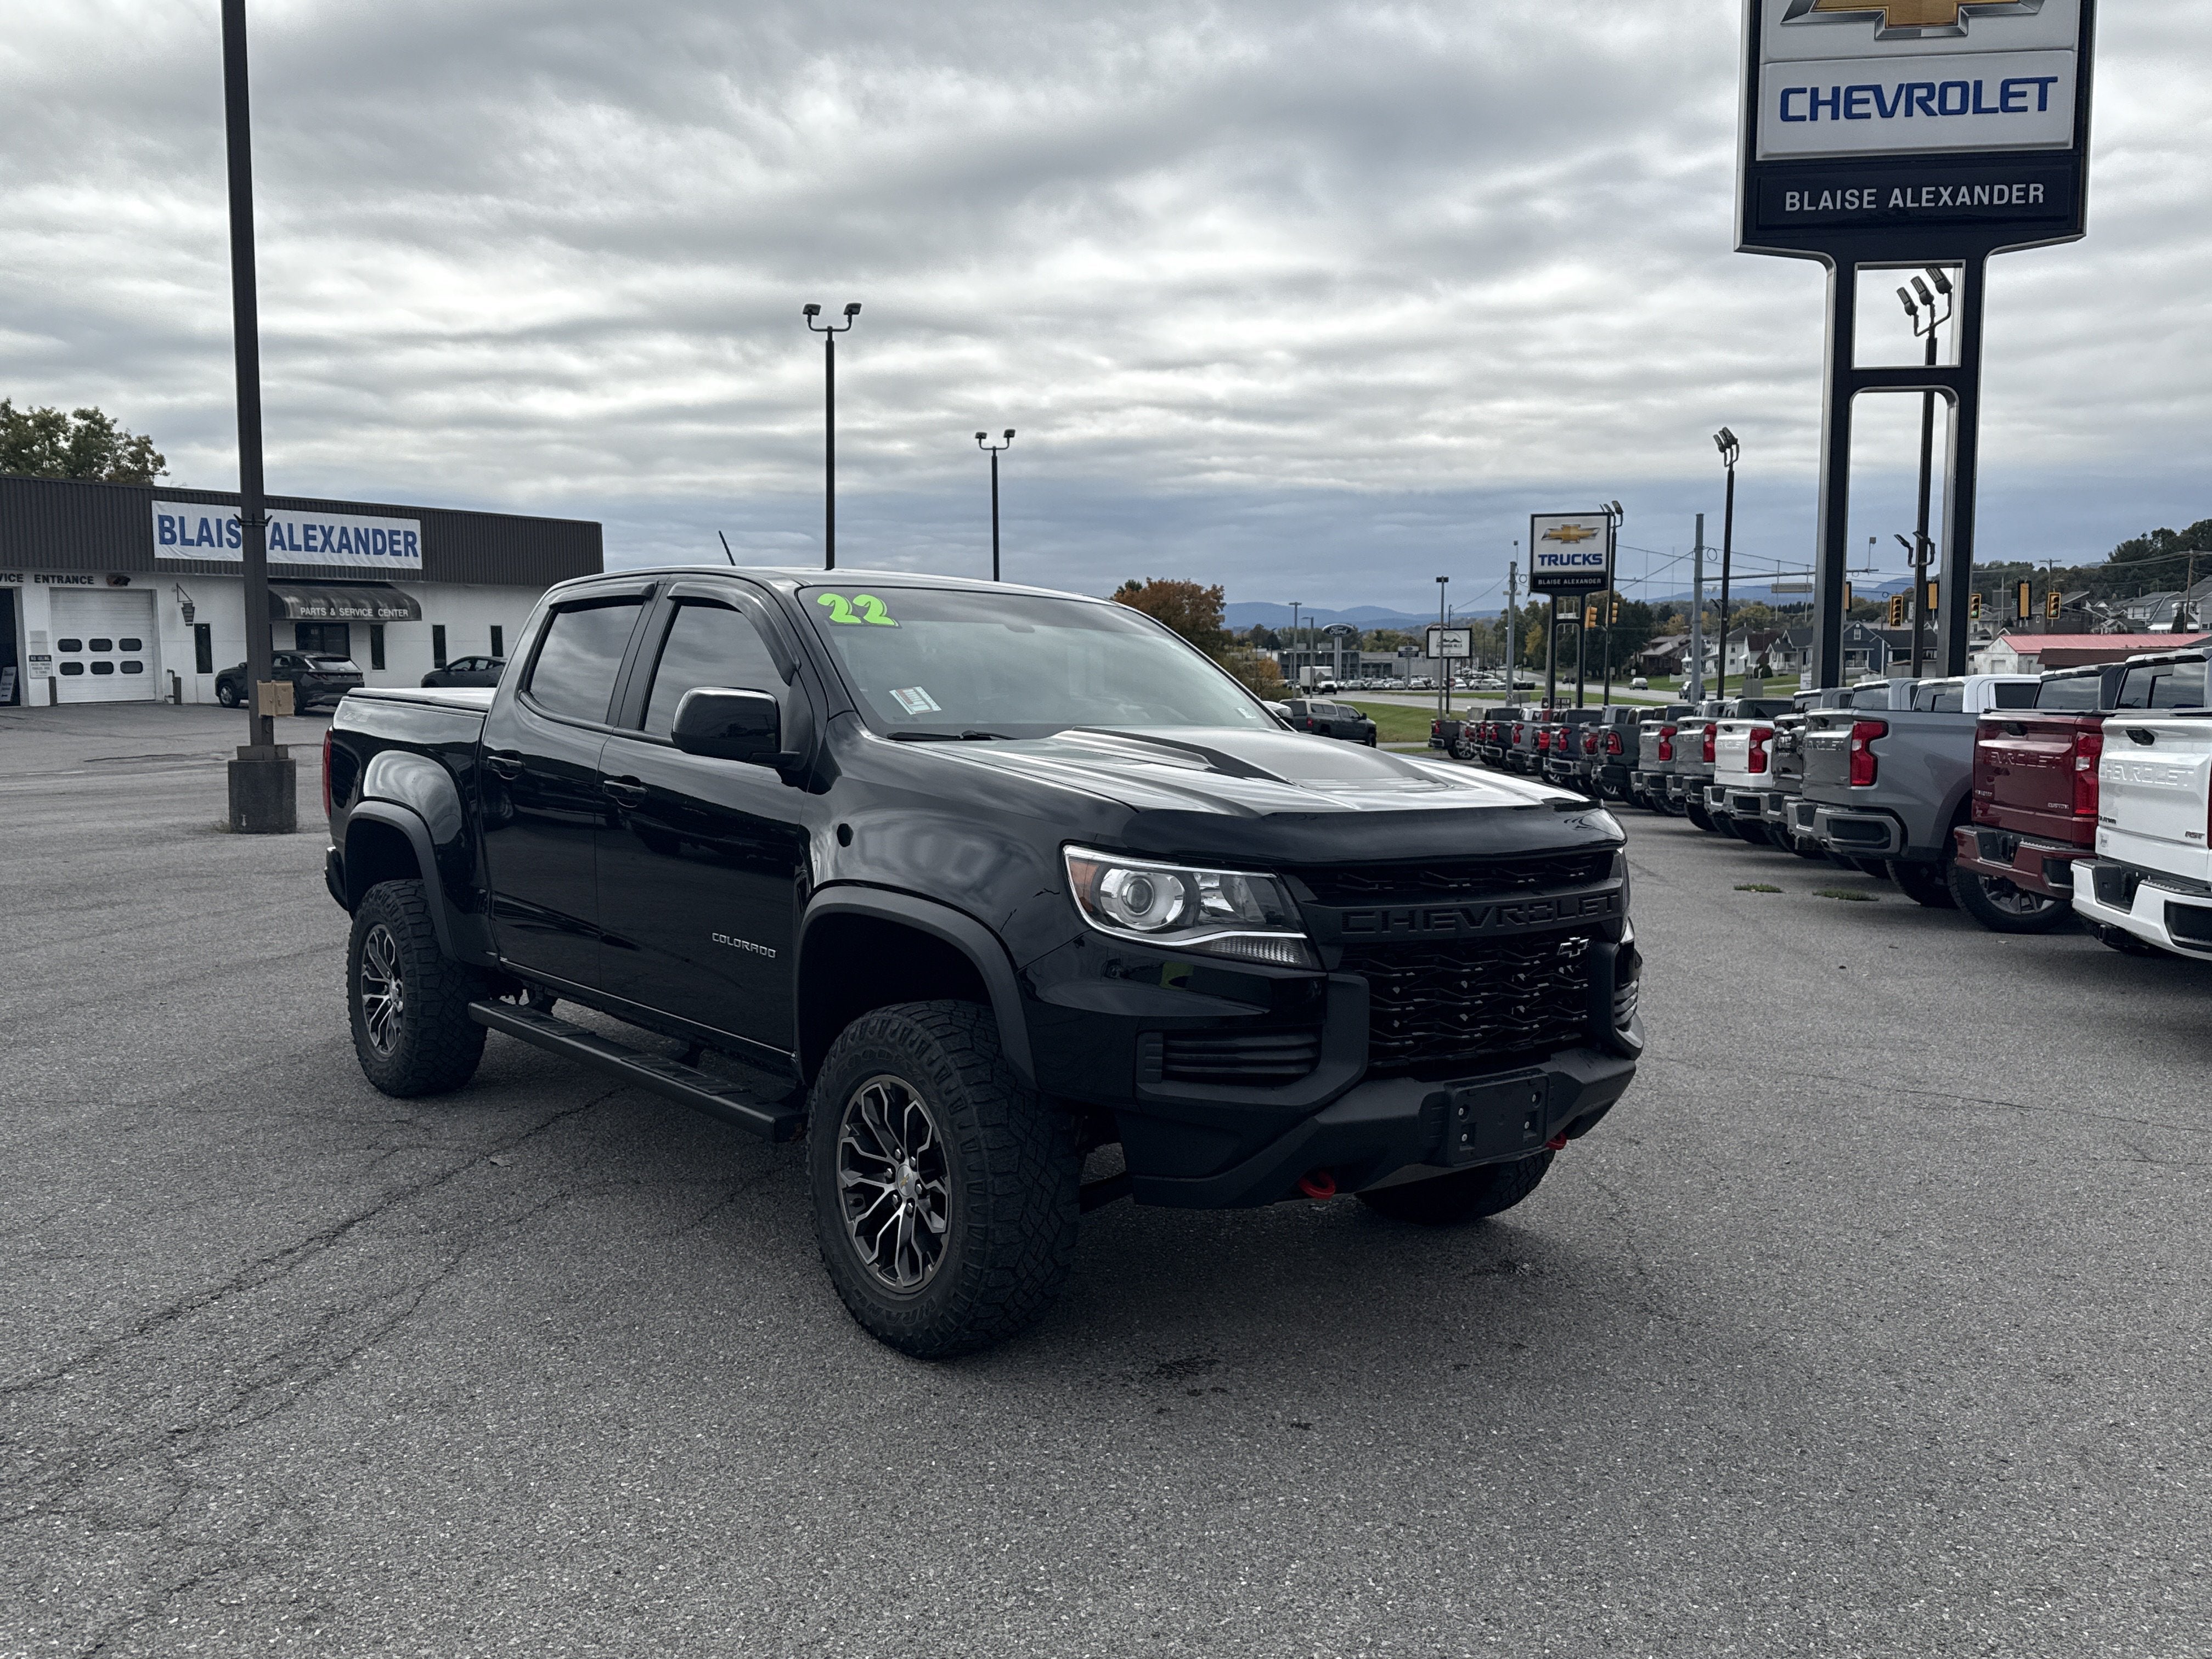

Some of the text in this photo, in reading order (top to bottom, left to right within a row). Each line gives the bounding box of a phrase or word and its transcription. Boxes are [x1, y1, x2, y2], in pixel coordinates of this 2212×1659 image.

[1780, 76, 2058, 122] CHEVROLET
[1785, 183, 2044, 211] BLAISE ALEXANDER
[158, 515, 419, 557] BLAIS ALEXANDER
[1538, 554, 1602, 566] TRUCKS
[34, 574, 94, 584] ENTRANCE
[300, 607, 326, 616] PARTS
[339, 607, 373, 617] SERVICE
[377, 608, 408, 617] CENTER
[817, 593, 899, 627] 22
[1329, 627, 1348, 635] Ford
[1341, 893, 1618, 935] CHEVROLET
[712, 933, 777, 958] COLORADO
